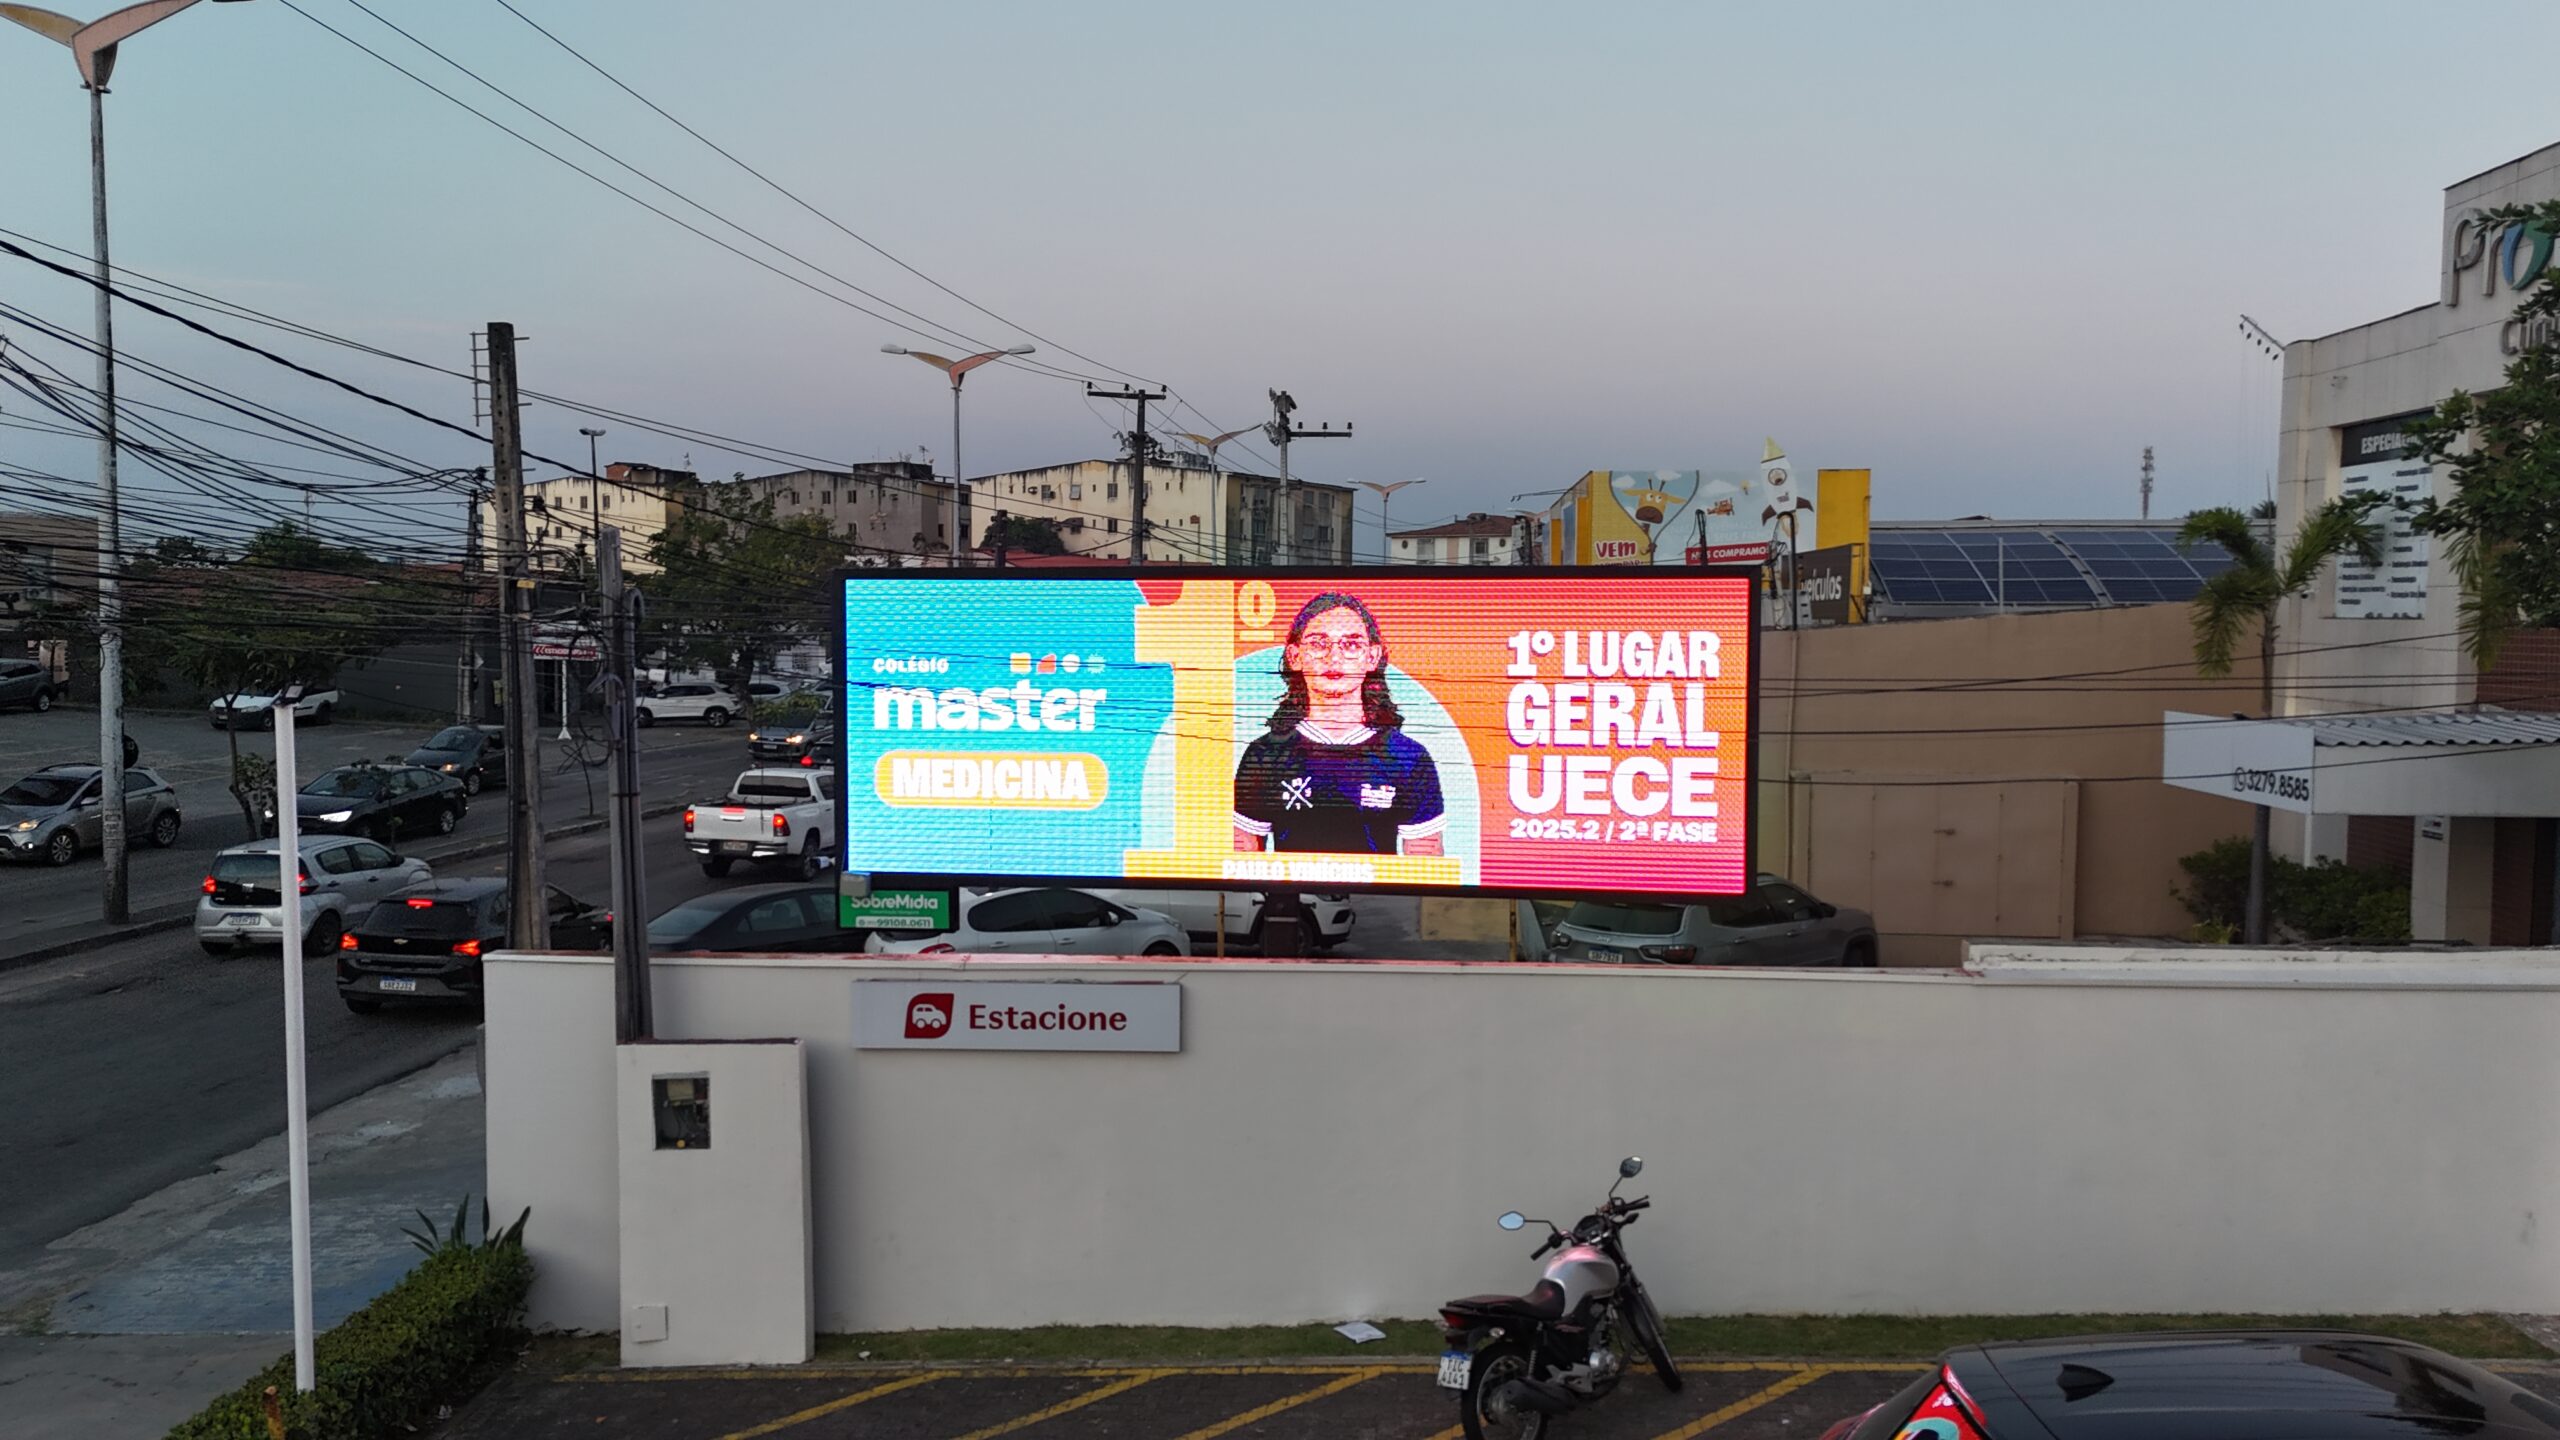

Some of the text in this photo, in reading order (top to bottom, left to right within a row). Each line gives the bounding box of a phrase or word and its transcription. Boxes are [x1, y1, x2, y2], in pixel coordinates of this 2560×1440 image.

[1563, 630, 1721, 679] LUGAR
[873, 679, 1108, 732] master
[1506, 681, 1720, 748] GERAL
[892, 757, 1091, 801] MEDICINA
[1508, 755, 1719, 817] UECE
[2246, 768, 2310, 802] 3279.8585
[1510, 819, 1599, 840] 2025.2
[1653, 821, 1718, 844] FASE
[968, 1003, 1128, 1032] Estacione
